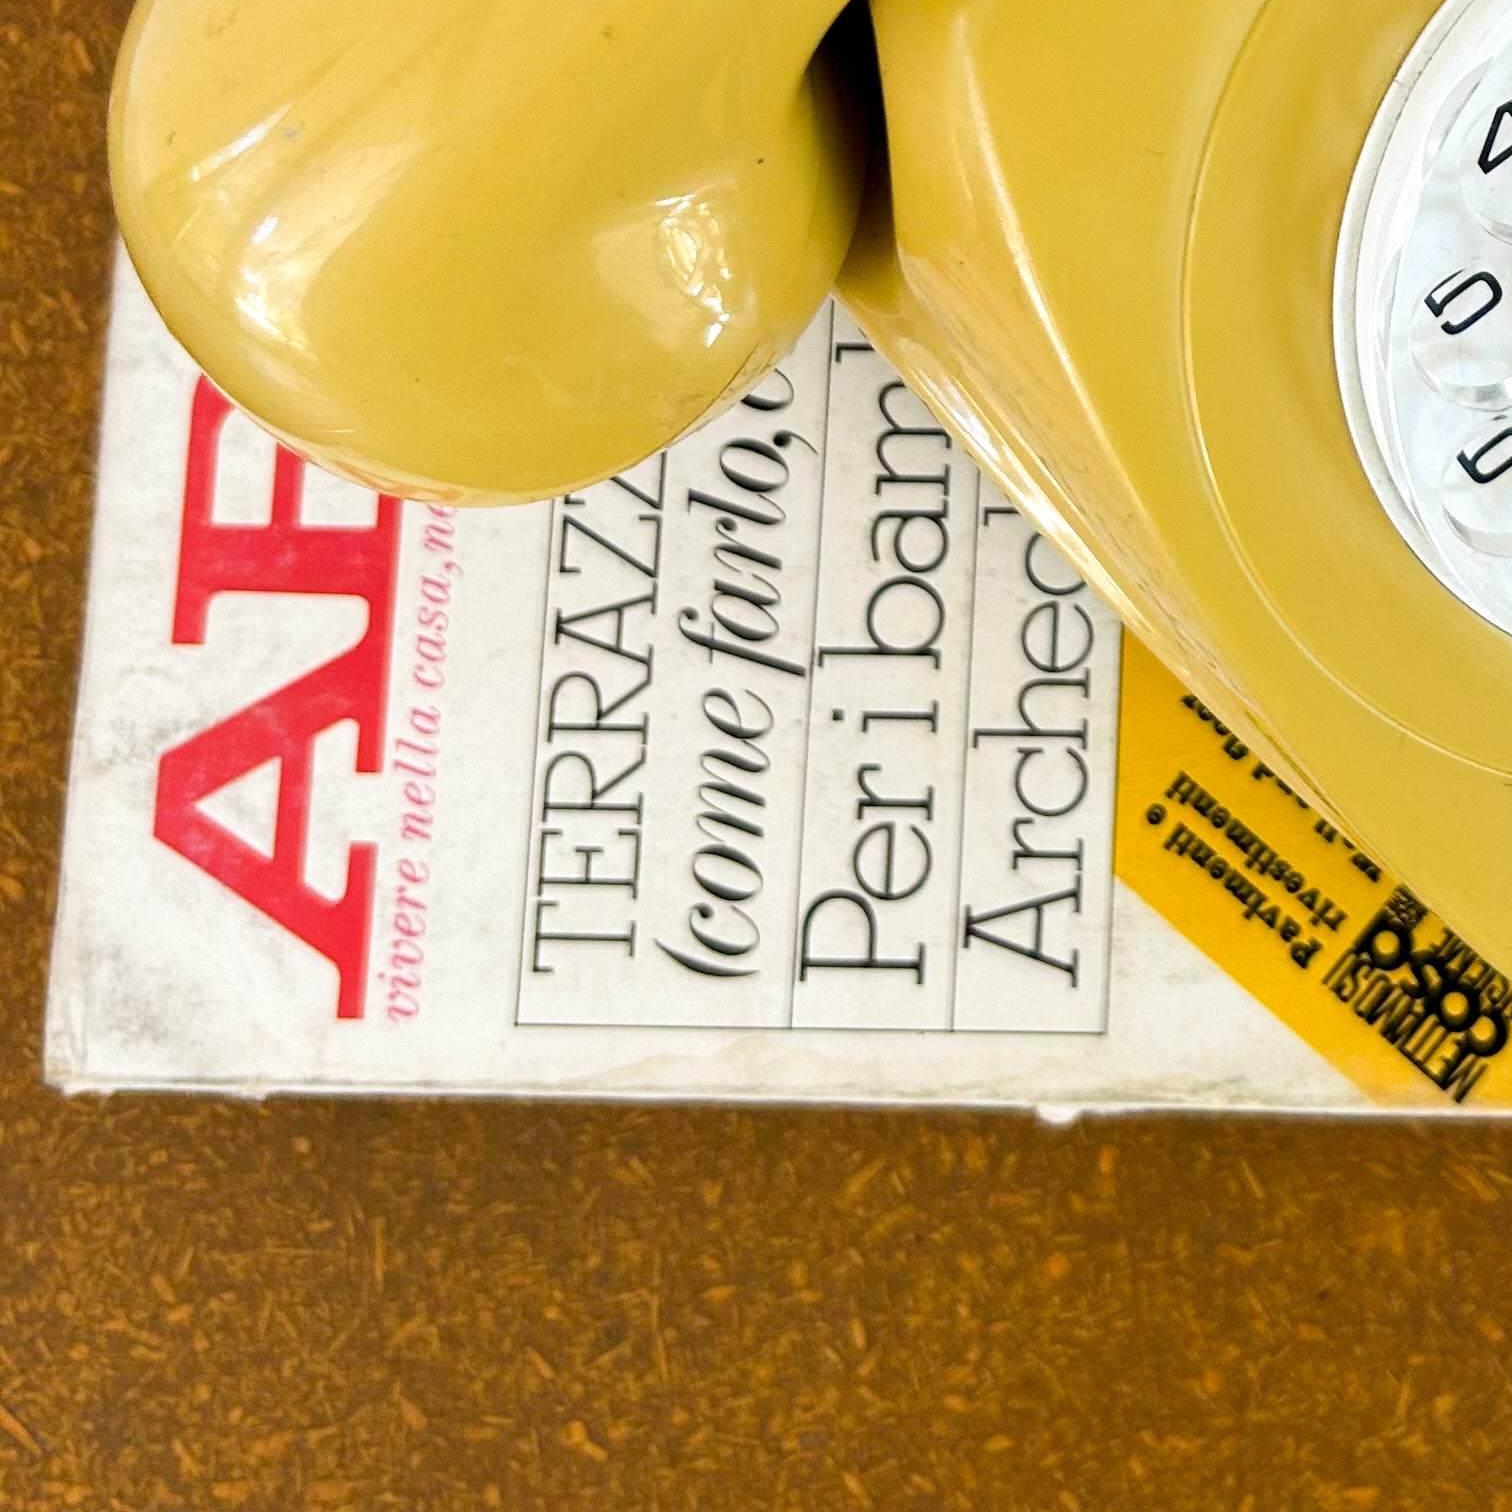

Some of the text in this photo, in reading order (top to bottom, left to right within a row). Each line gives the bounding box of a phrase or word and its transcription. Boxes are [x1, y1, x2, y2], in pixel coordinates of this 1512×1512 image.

[1424, 268, 1502, 336] 5
[392, 705, 442, 843] nella
[831, 699, 940, 735] i
[653, 688, 775, 980] (come
[797, 762, 936, 988] Per
[1144, 802, 1169, 826] e
[1163, 769, 1351, 933] rivestimenti
[376, 857, 431, 1023] vivere
[1162, 821, 1326, 971] Pavimenti
